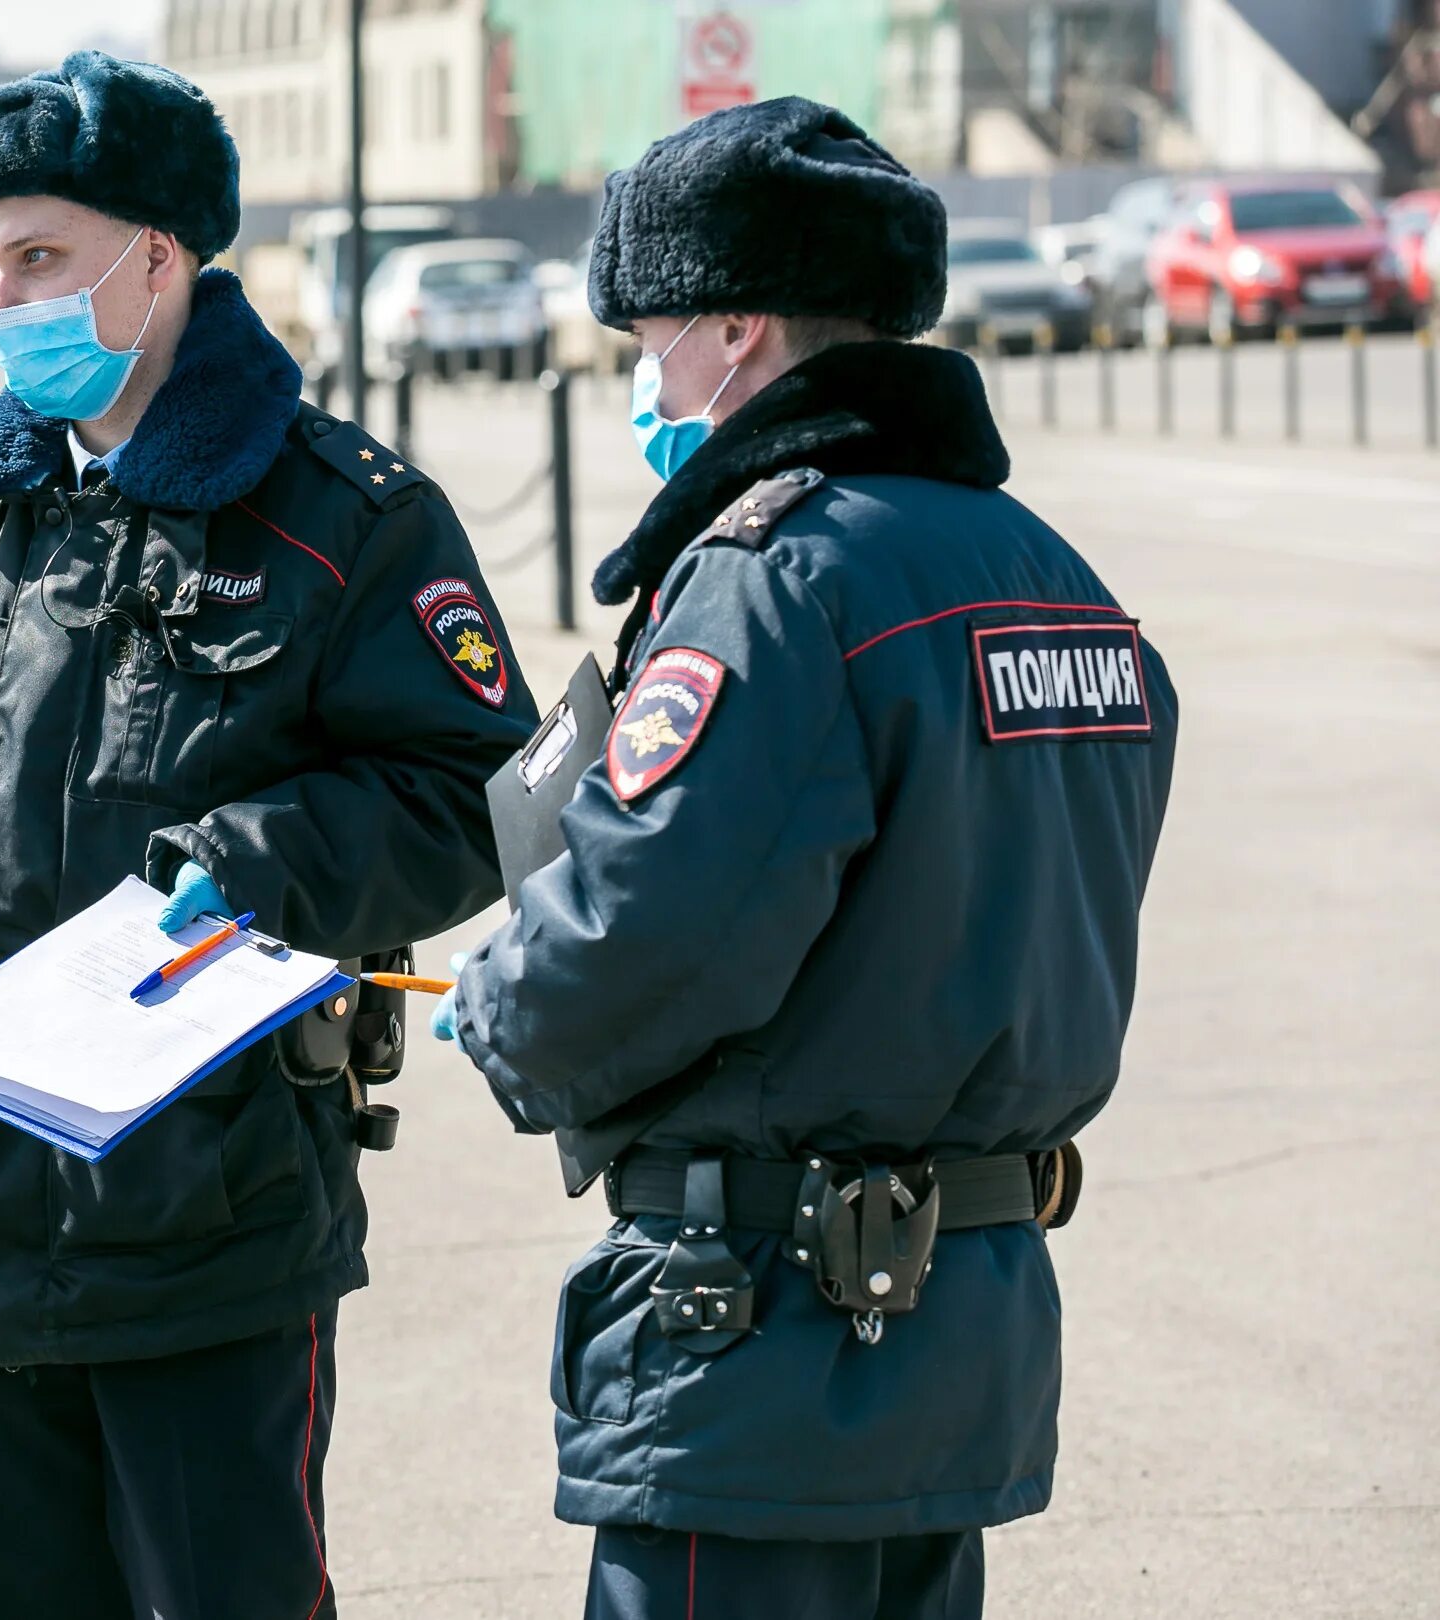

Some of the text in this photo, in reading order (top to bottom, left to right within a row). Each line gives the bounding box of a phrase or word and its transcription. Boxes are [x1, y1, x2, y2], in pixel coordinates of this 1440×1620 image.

[417, 581, 471, 609] ПОЛИЦИЯ
[436, 607, 483, 635] РОССИЯ
[481, 682, 505, 703] МВД
[637, 683, 699, 715] РОССИЯ
